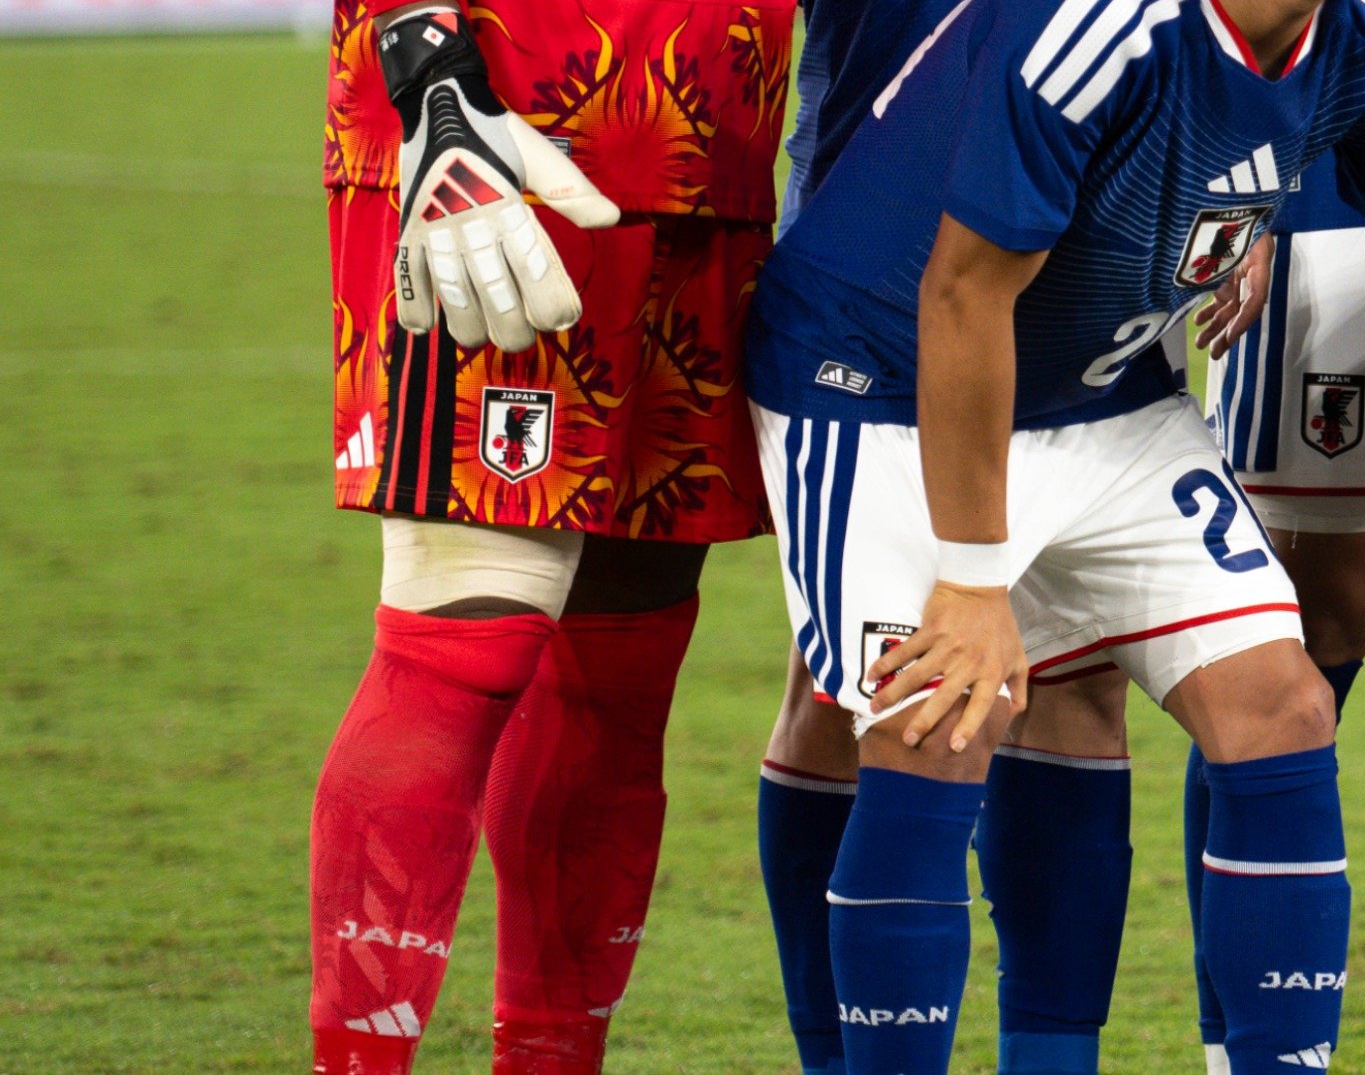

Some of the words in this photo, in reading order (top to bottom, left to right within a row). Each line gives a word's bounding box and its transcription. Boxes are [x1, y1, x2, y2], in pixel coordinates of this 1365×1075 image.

[401, 246, 416, 301] PRED
[1317, 375, 1350, 384] JAPAN
[500, 391, 538, 401] JAPAN
[875, 625, 913, 634] JAPAN
[335, 919, 457, 959] JAPA
[1258, 971, 1348, 992] JAPA
[838, 1003, 950, 1028] JAPAN
